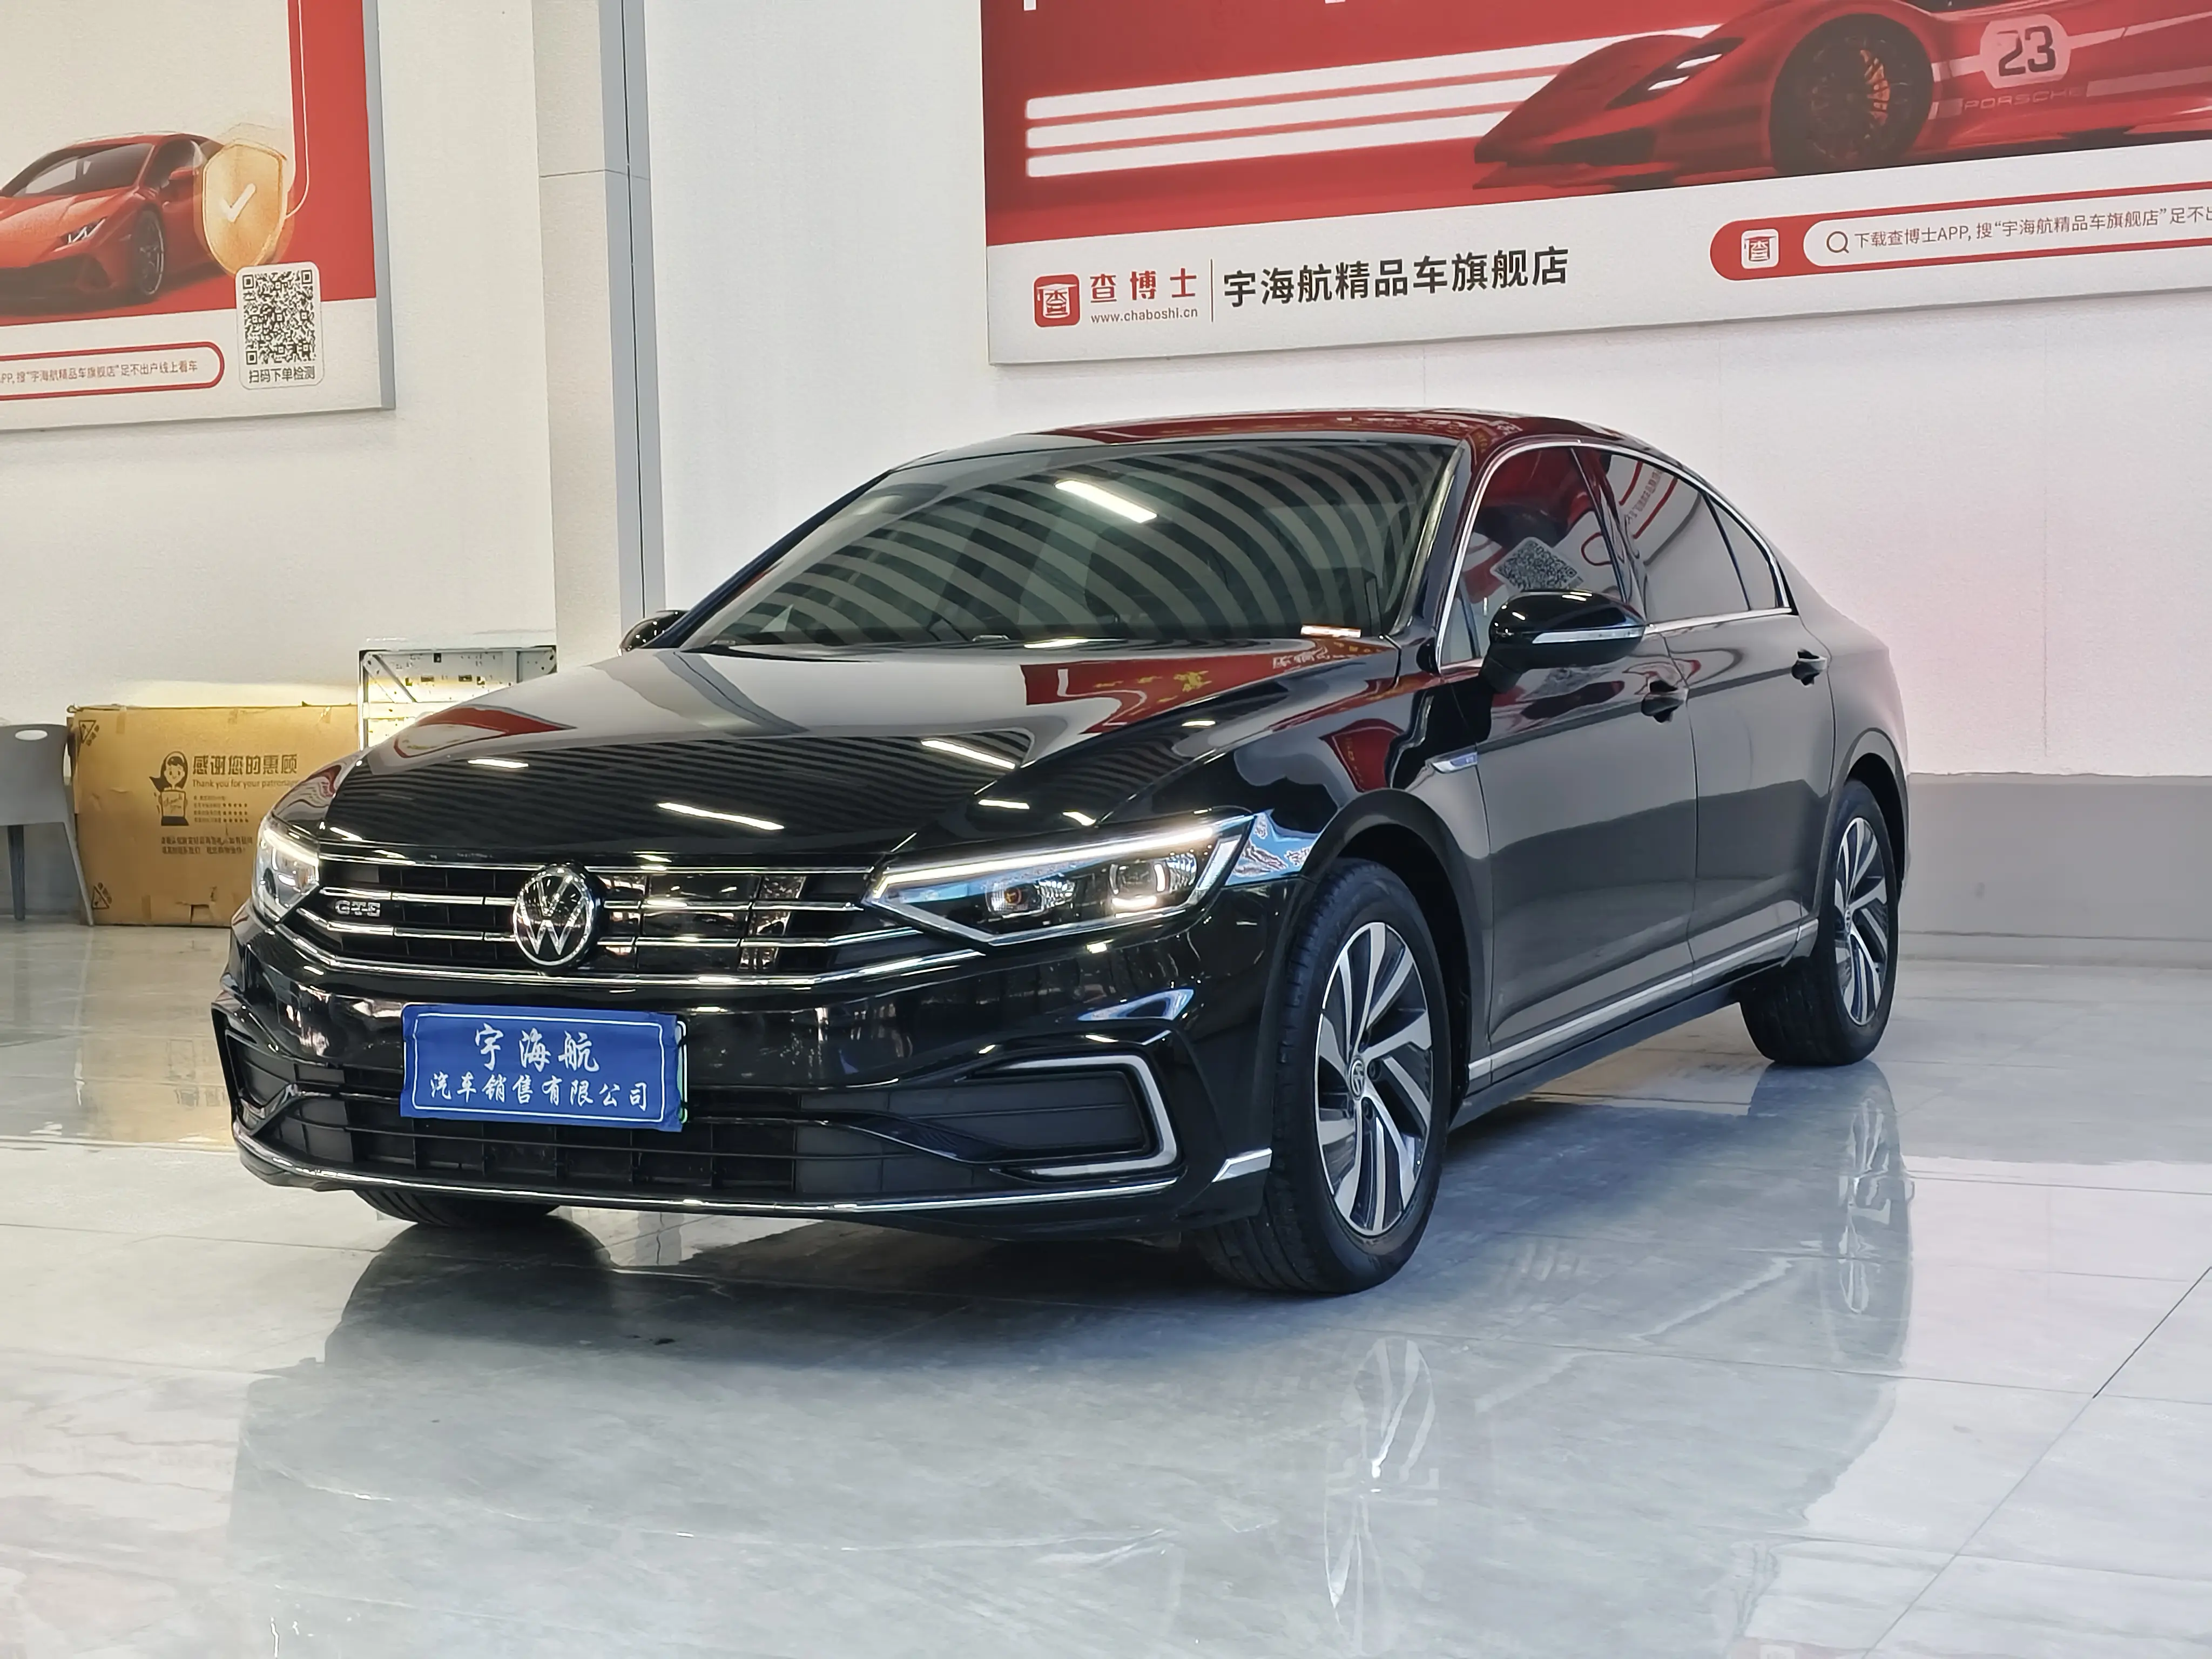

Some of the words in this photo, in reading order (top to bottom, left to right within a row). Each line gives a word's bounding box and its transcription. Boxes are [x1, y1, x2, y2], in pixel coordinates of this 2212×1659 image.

[1997, 25, 2056, 77] 23
[1090, 268, 1197, 303] 查博士
[1223, 246, 1568, 308] 宇海航精品车旗舰店
[1090, 307, 1198, 323] www.chaboshi.cn
[249, 365, 315, 383] 扫码下单检测
[192, 754, 298, 775] 感谢您的惠顾
[215, 781, 229, 790] you
[231, 779, 241, 787] for
[475, 1022, 599, 1072] 宇海航
[430, 1071, 649, 1111] 汽车销售有限公司
